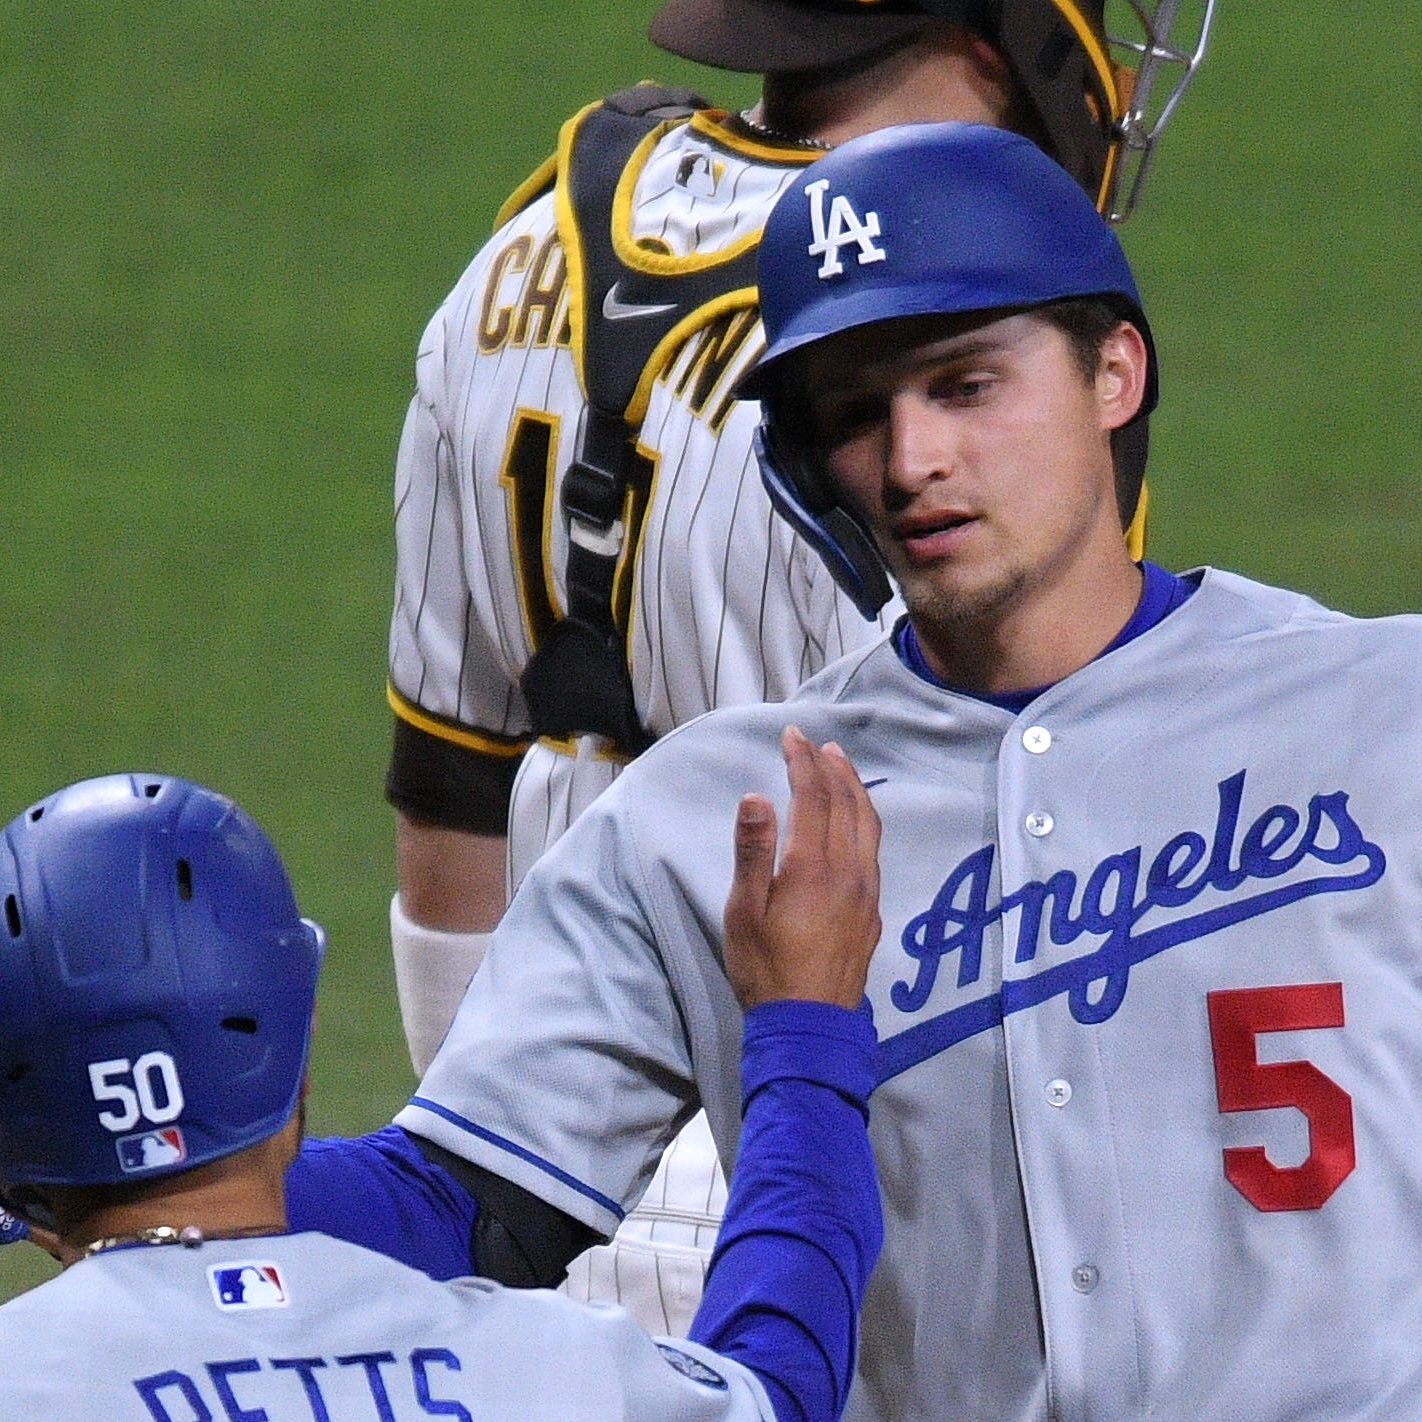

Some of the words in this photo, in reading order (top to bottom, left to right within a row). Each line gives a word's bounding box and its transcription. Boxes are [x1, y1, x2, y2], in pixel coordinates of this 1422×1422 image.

[804, 179, 886, 279] LA
[890, 769, 1386, 1024] Angeles
[88, 1050, 185, 1133] 50
[1207, 982, 1356, 1213] 5
